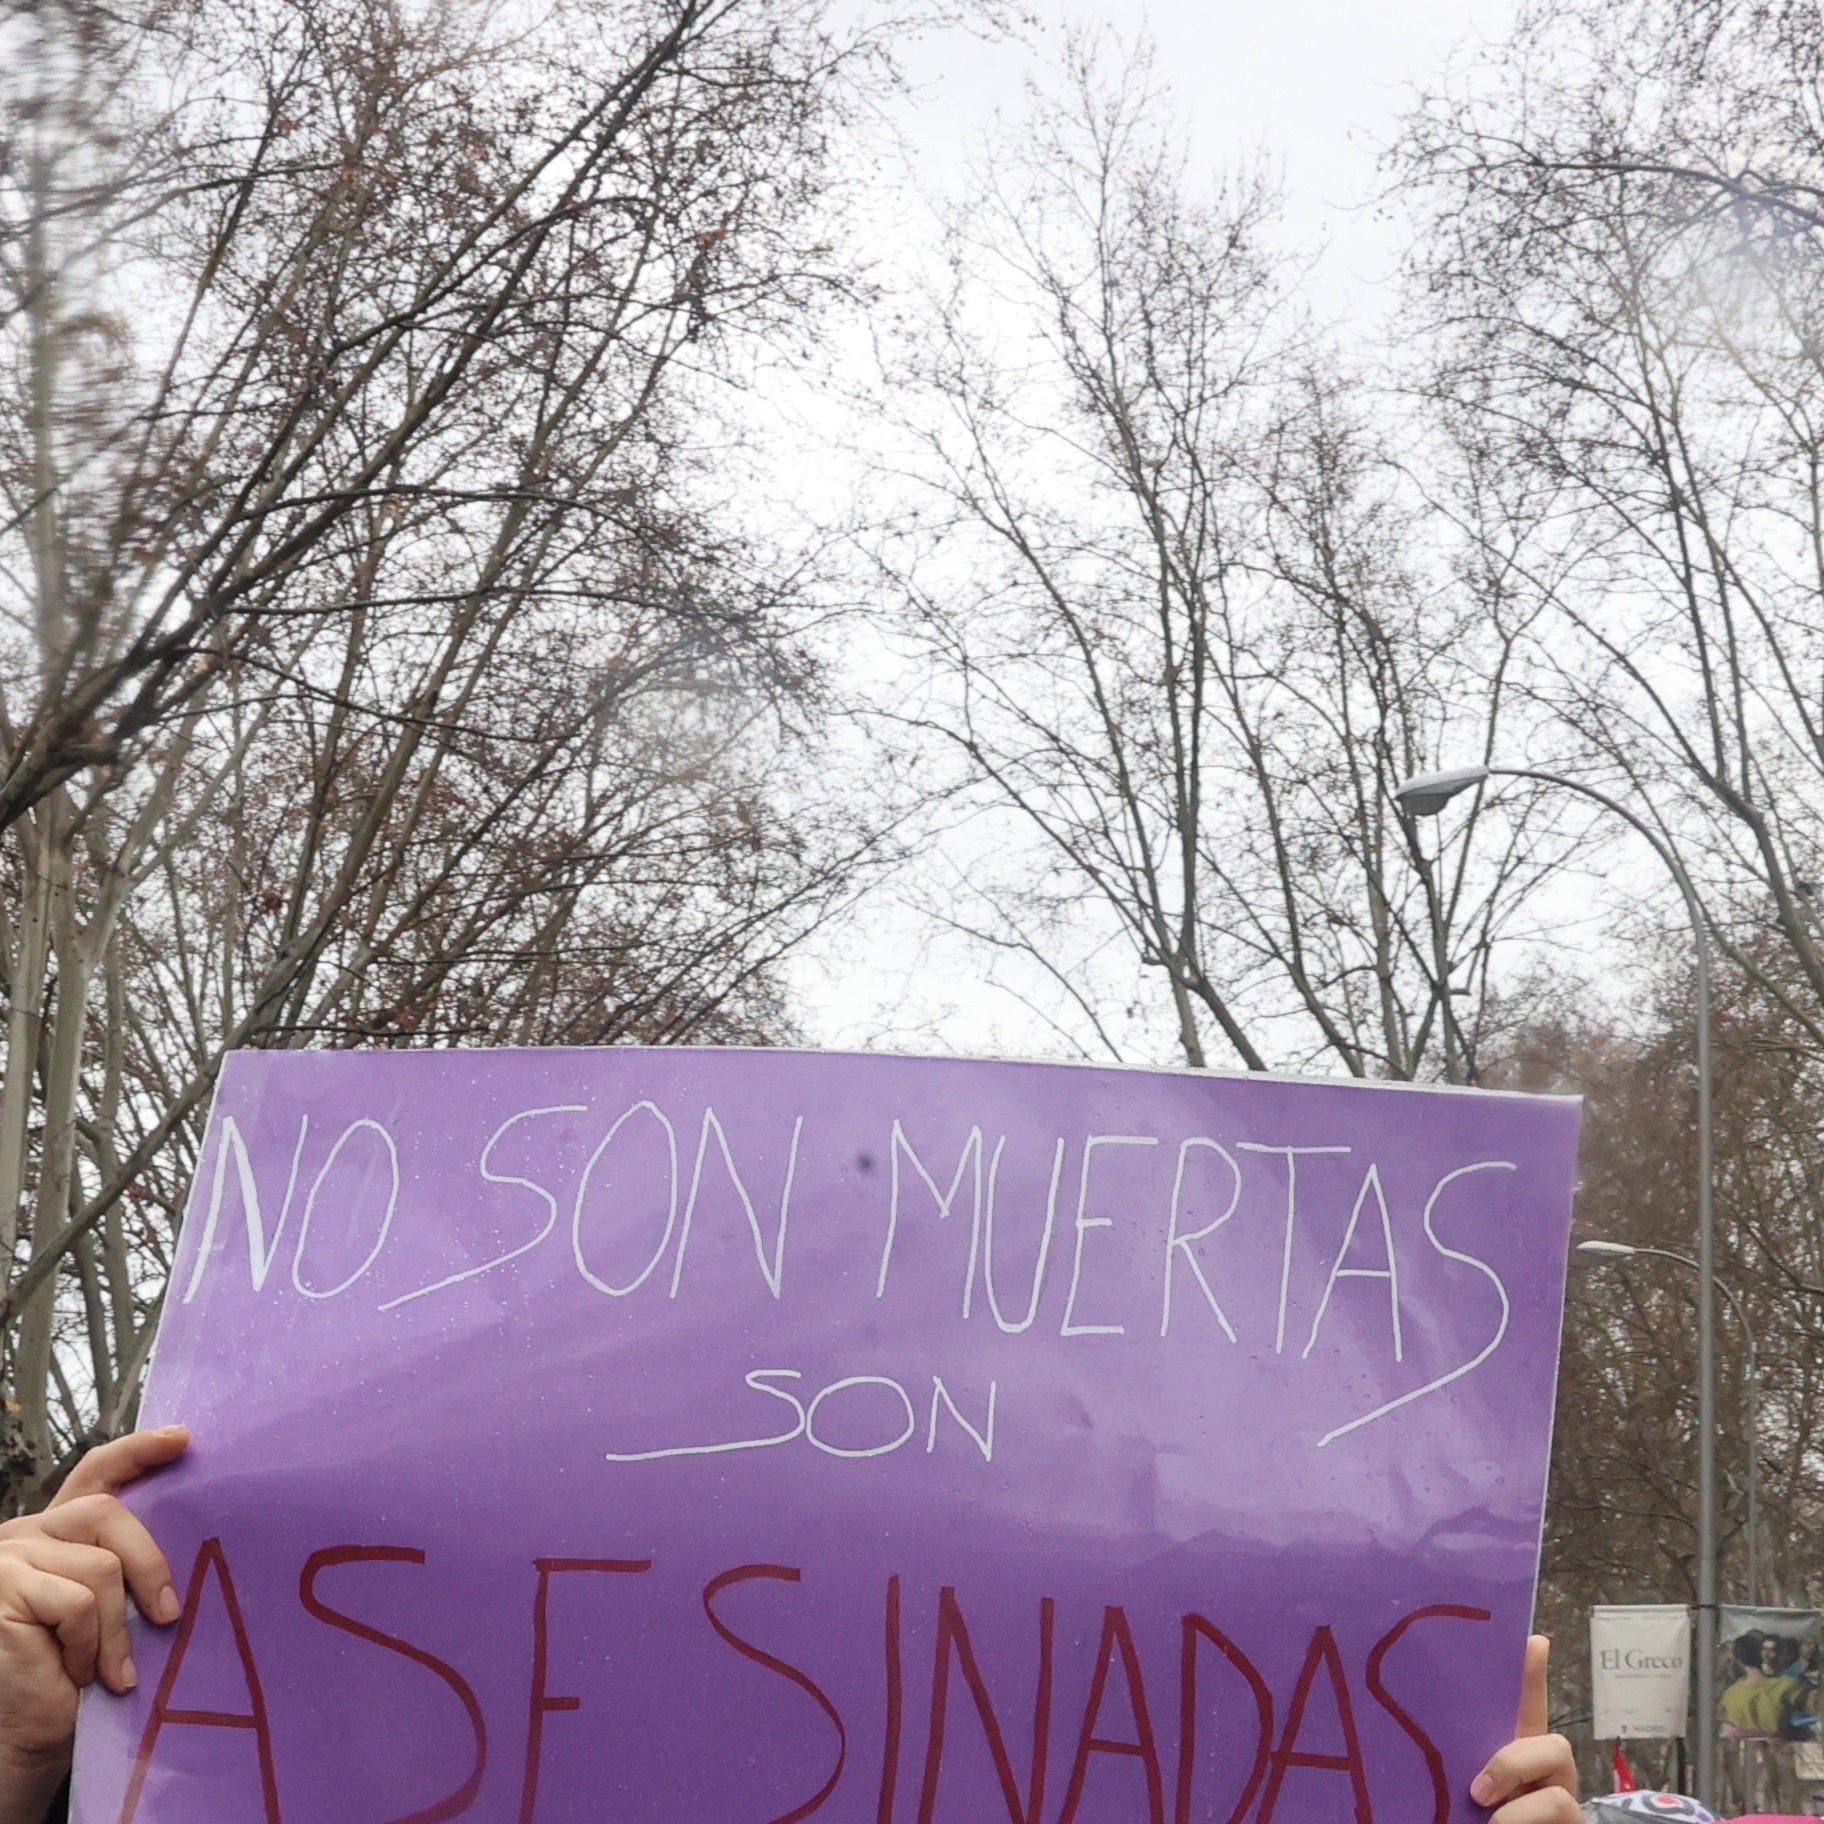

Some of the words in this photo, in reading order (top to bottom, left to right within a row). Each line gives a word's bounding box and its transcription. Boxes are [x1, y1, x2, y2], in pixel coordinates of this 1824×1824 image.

[184, 1113, 401, 1305] NO
[378, 1100, 803, 1312] SON
[876, 1116, 1518, 1447] MUERTAS
[606, 1369, 997, 1462] SON
[1601, 1648, 1620, 1670] El
[1625, 1648, 1682, 1670] Greco
